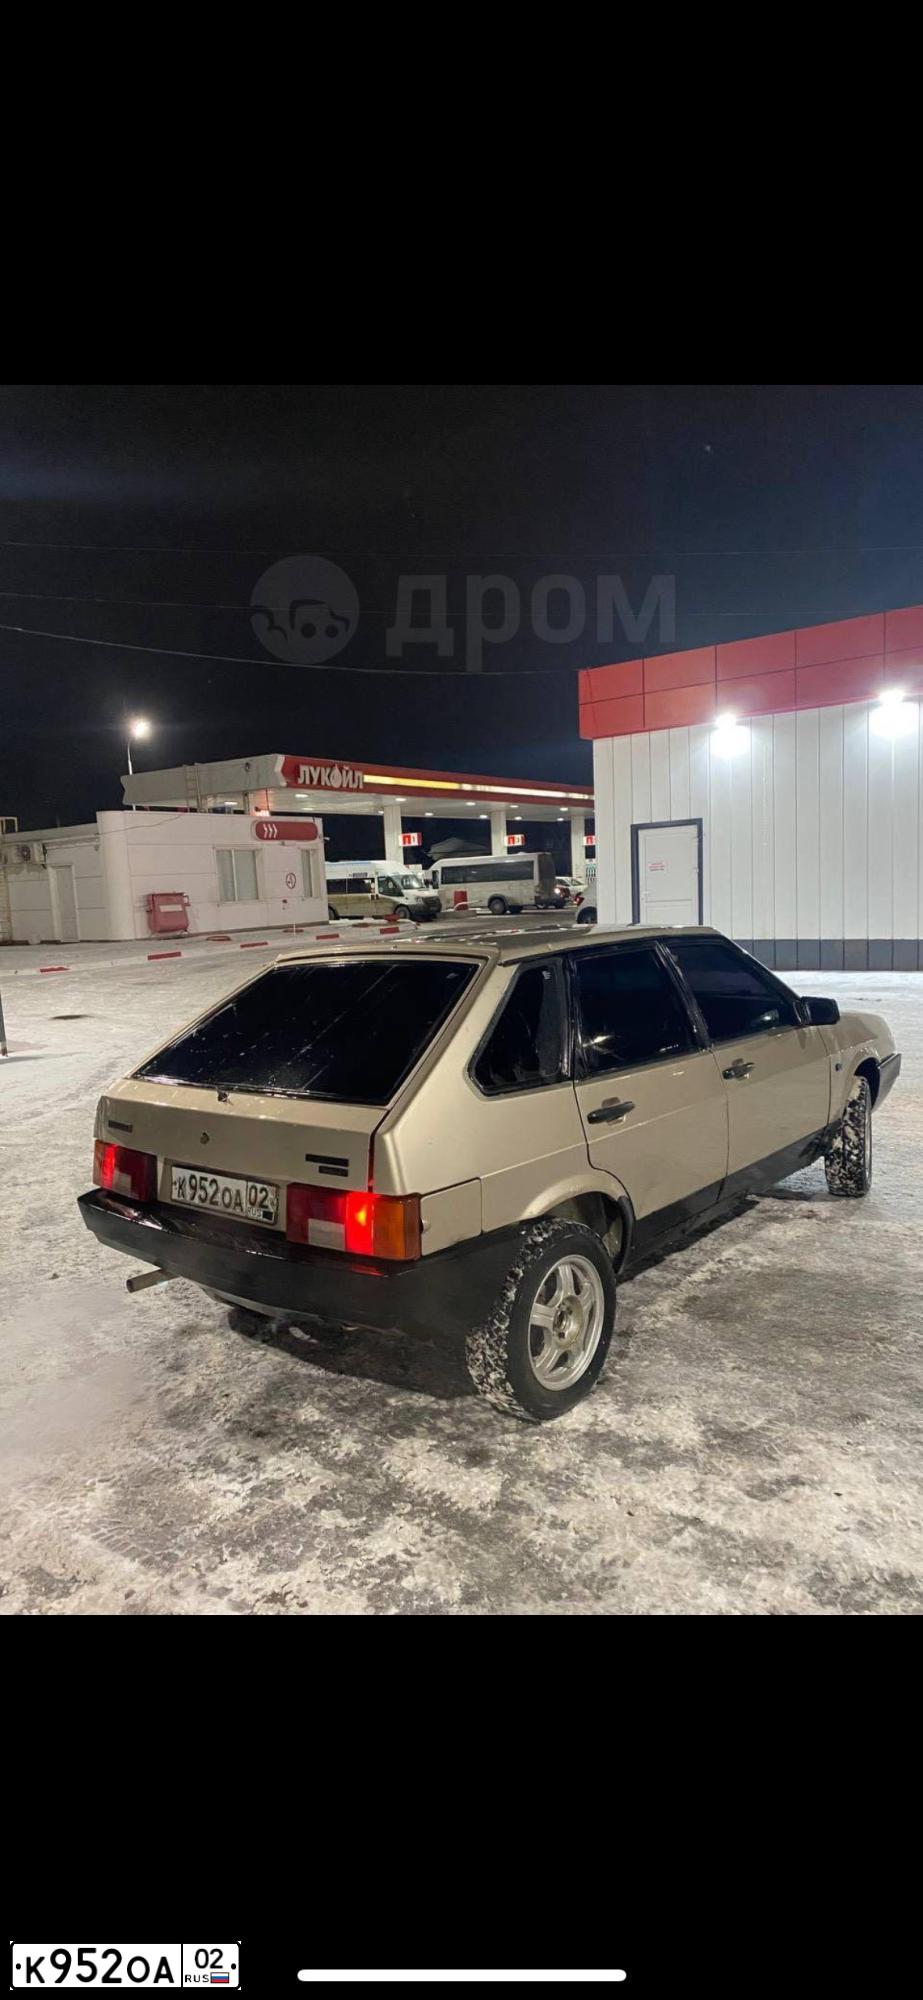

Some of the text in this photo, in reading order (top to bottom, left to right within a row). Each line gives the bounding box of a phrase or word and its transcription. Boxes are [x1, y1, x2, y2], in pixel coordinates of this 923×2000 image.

[297, 763, 364, 789] ЛУКОЙЛ
[177, 1174, 270, 1213] К952ОА 02
